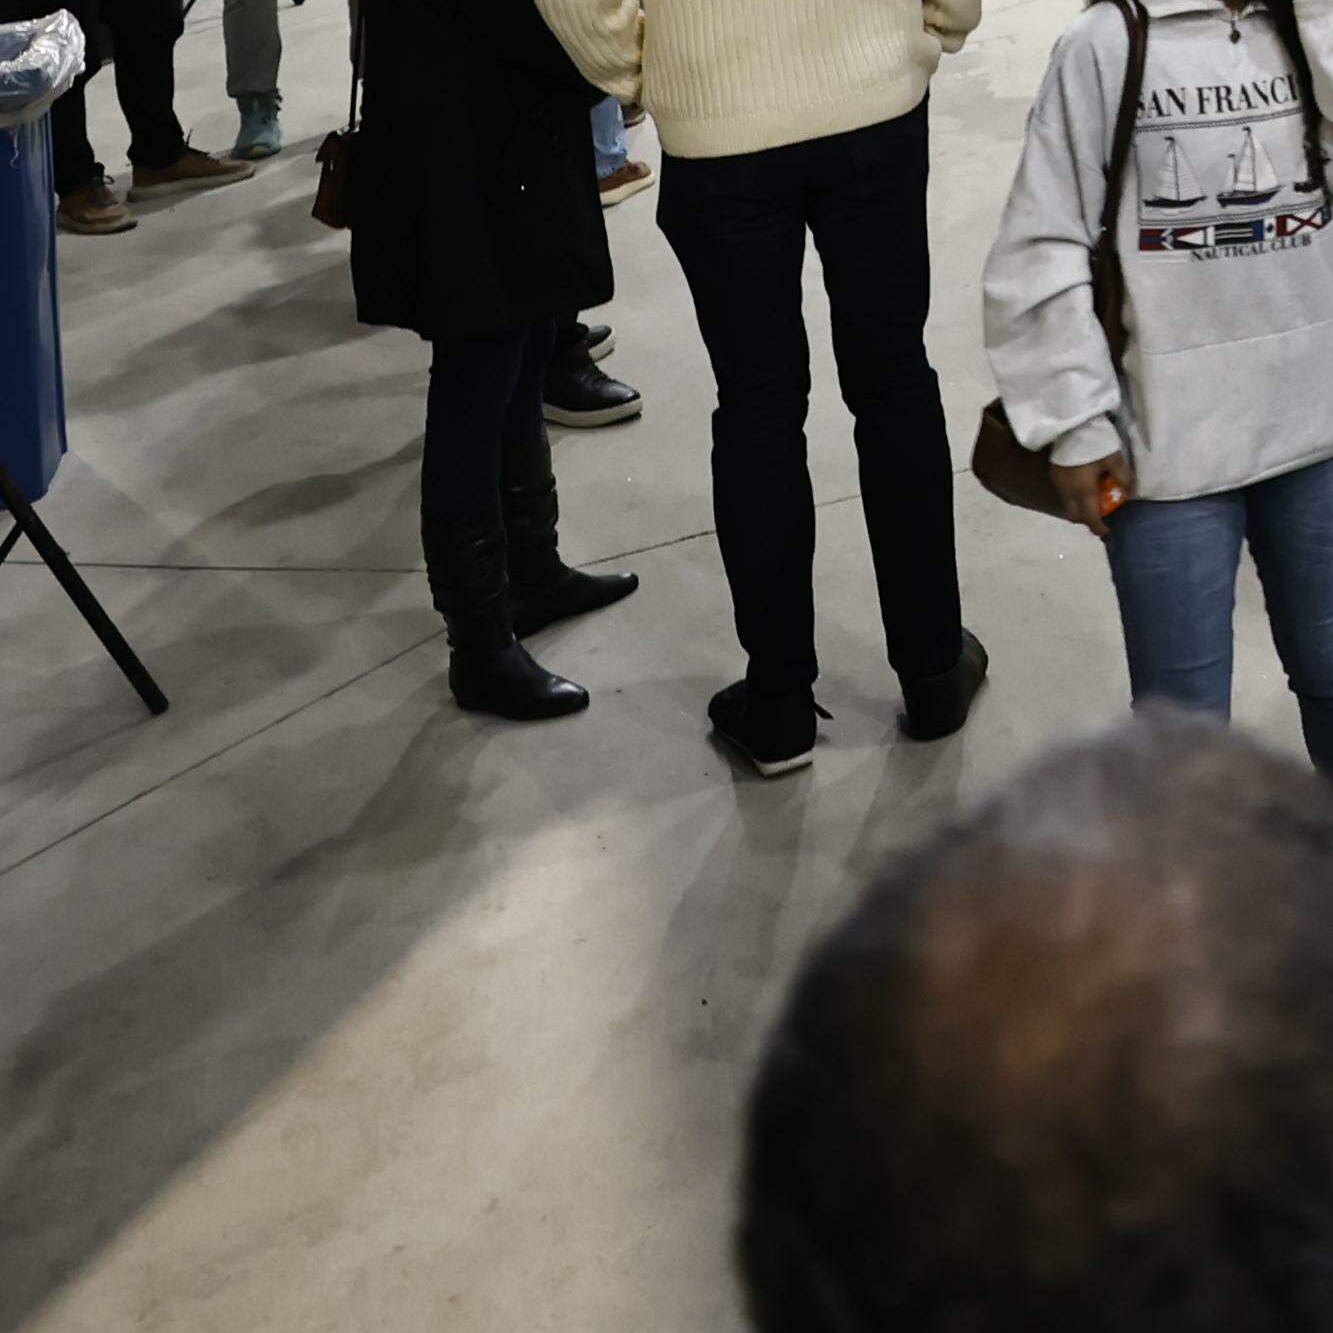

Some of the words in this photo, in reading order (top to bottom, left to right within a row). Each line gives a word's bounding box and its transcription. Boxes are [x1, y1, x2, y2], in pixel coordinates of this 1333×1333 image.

[1196, 75, 1299, 114] FRANCI
[1191, 240, 1268, 262] NAUTICAL
[1270, 233, 1312, 252] CLUB
